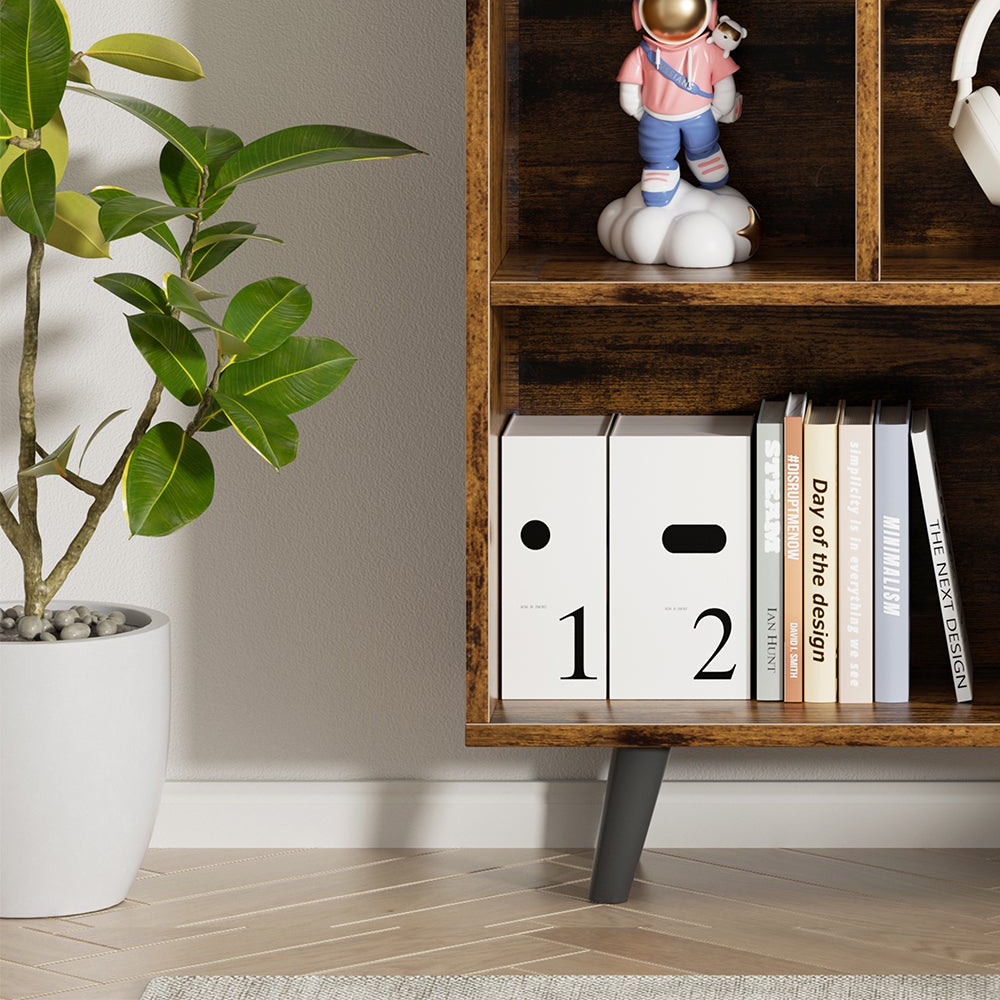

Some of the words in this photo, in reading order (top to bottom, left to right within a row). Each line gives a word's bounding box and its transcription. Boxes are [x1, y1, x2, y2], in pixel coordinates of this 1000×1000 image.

[764, 439, 781, 553] STEAM
[847, 441, 862, 515] simplicity
[786, 454, 800, 561] #DISRUPTMENOW
[809, 478, 829, 519] Day
[812, 525, 829, 548] of
[850, 519, 862, 531] is
[850, 537, 862, 551] in
[929, 519, 945, 556] THE
[812, 552, 829, 587] the
[882, 515, 901, 617] MINIMALISM
[847, 556, 862, 634] everything
[936, 562, 955, 612] NEXT
[767, 607, 778, 631] IAN
[789, 622, 799, 646] DAVID
[809, 593, 829, 663] design
[558, 606, 598, 681] 1
[693, 607, 737, 681] 2
[767, 634, 778, 673] HUNT
[850, 639, 860, 657] we
[946, 618, 968, 690] DESIGN
[789, 653, 799, 679] SMITH
[850, 663, 860, 687] see
